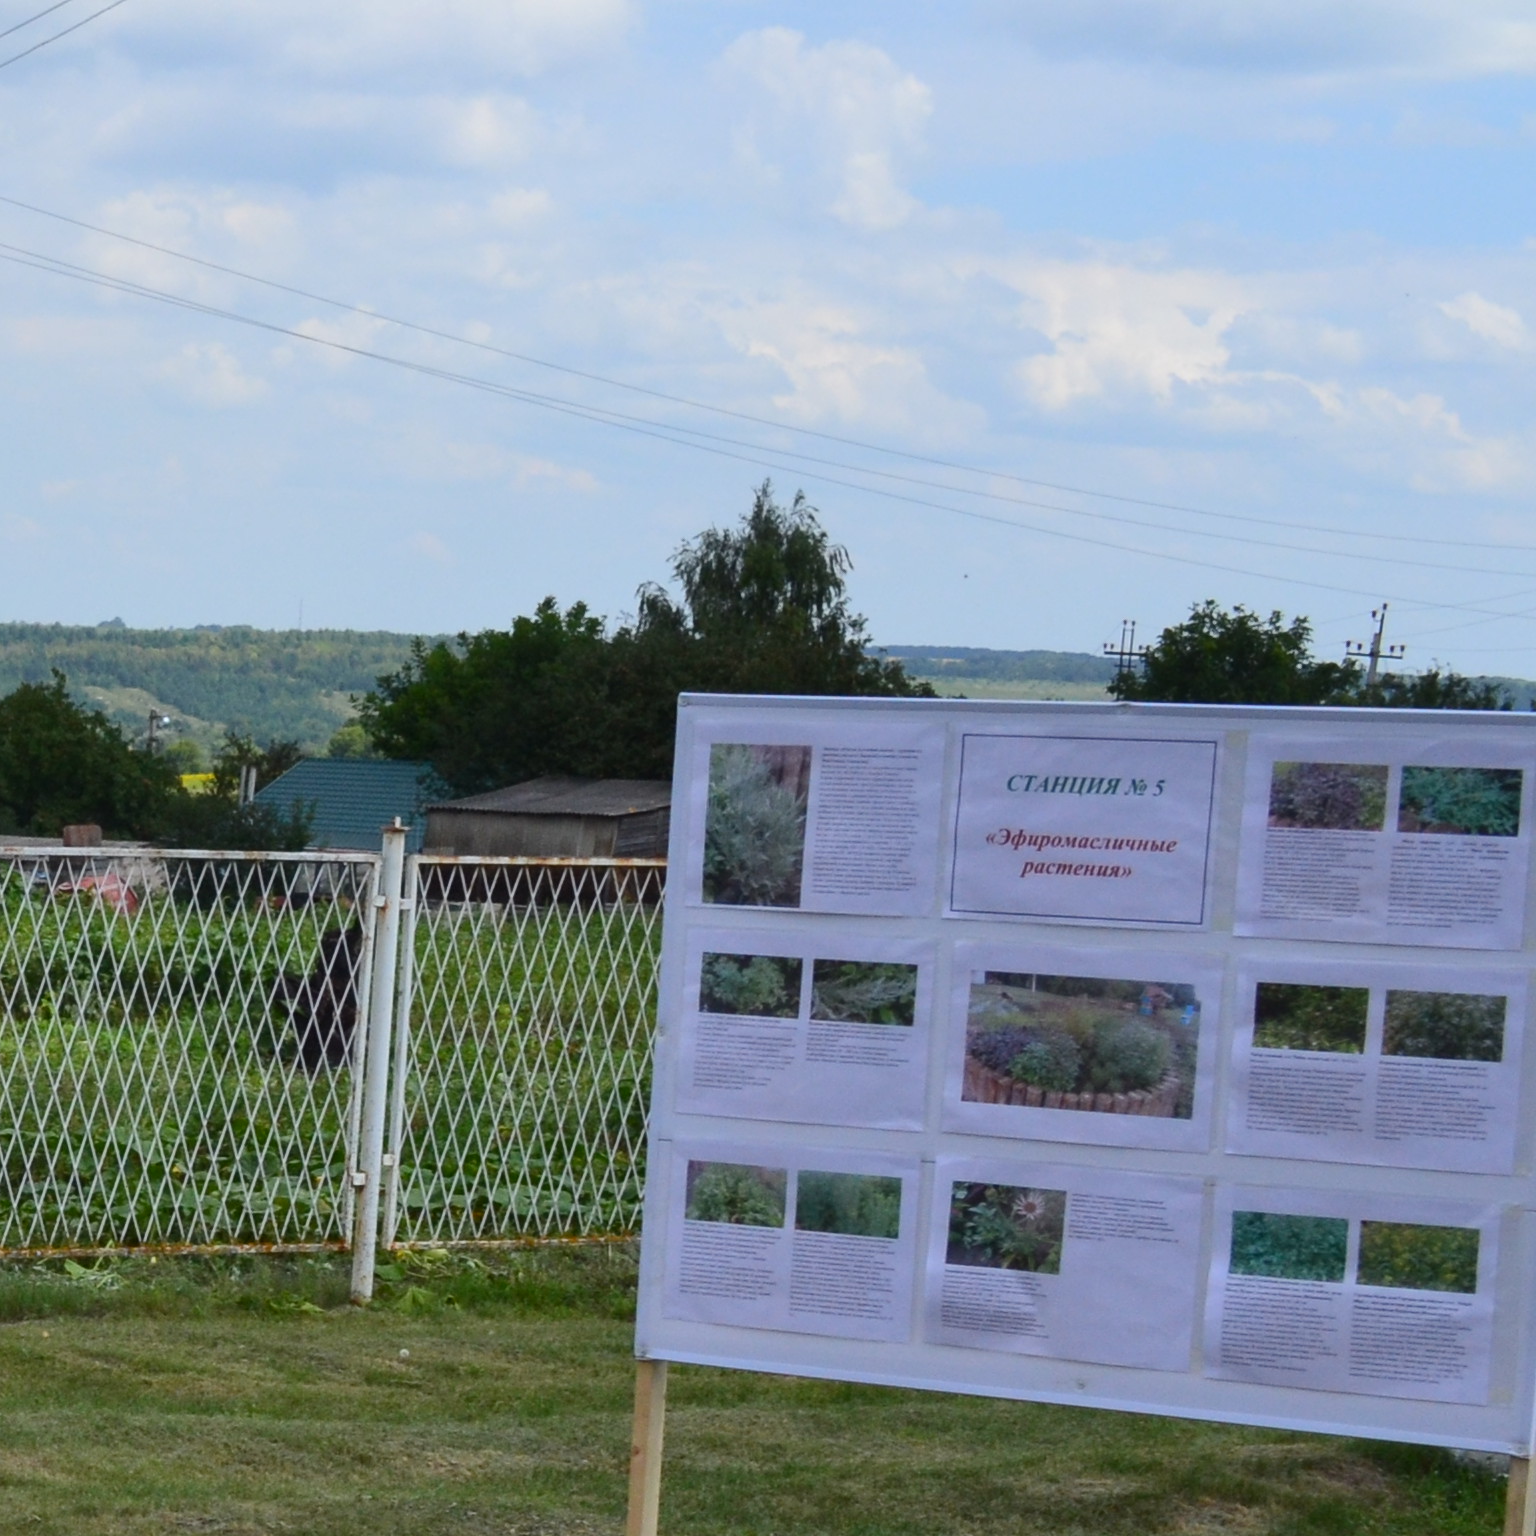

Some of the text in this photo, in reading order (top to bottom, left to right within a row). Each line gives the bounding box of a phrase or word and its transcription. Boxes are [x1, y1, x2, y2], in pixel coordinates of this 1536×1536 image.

[1006, 774, 1165, 796] СТАНЦИЯ № 5
[985, 828, 1177, 853] «Эфиромасличные
[1020, 860, 1132, 878] растения»
